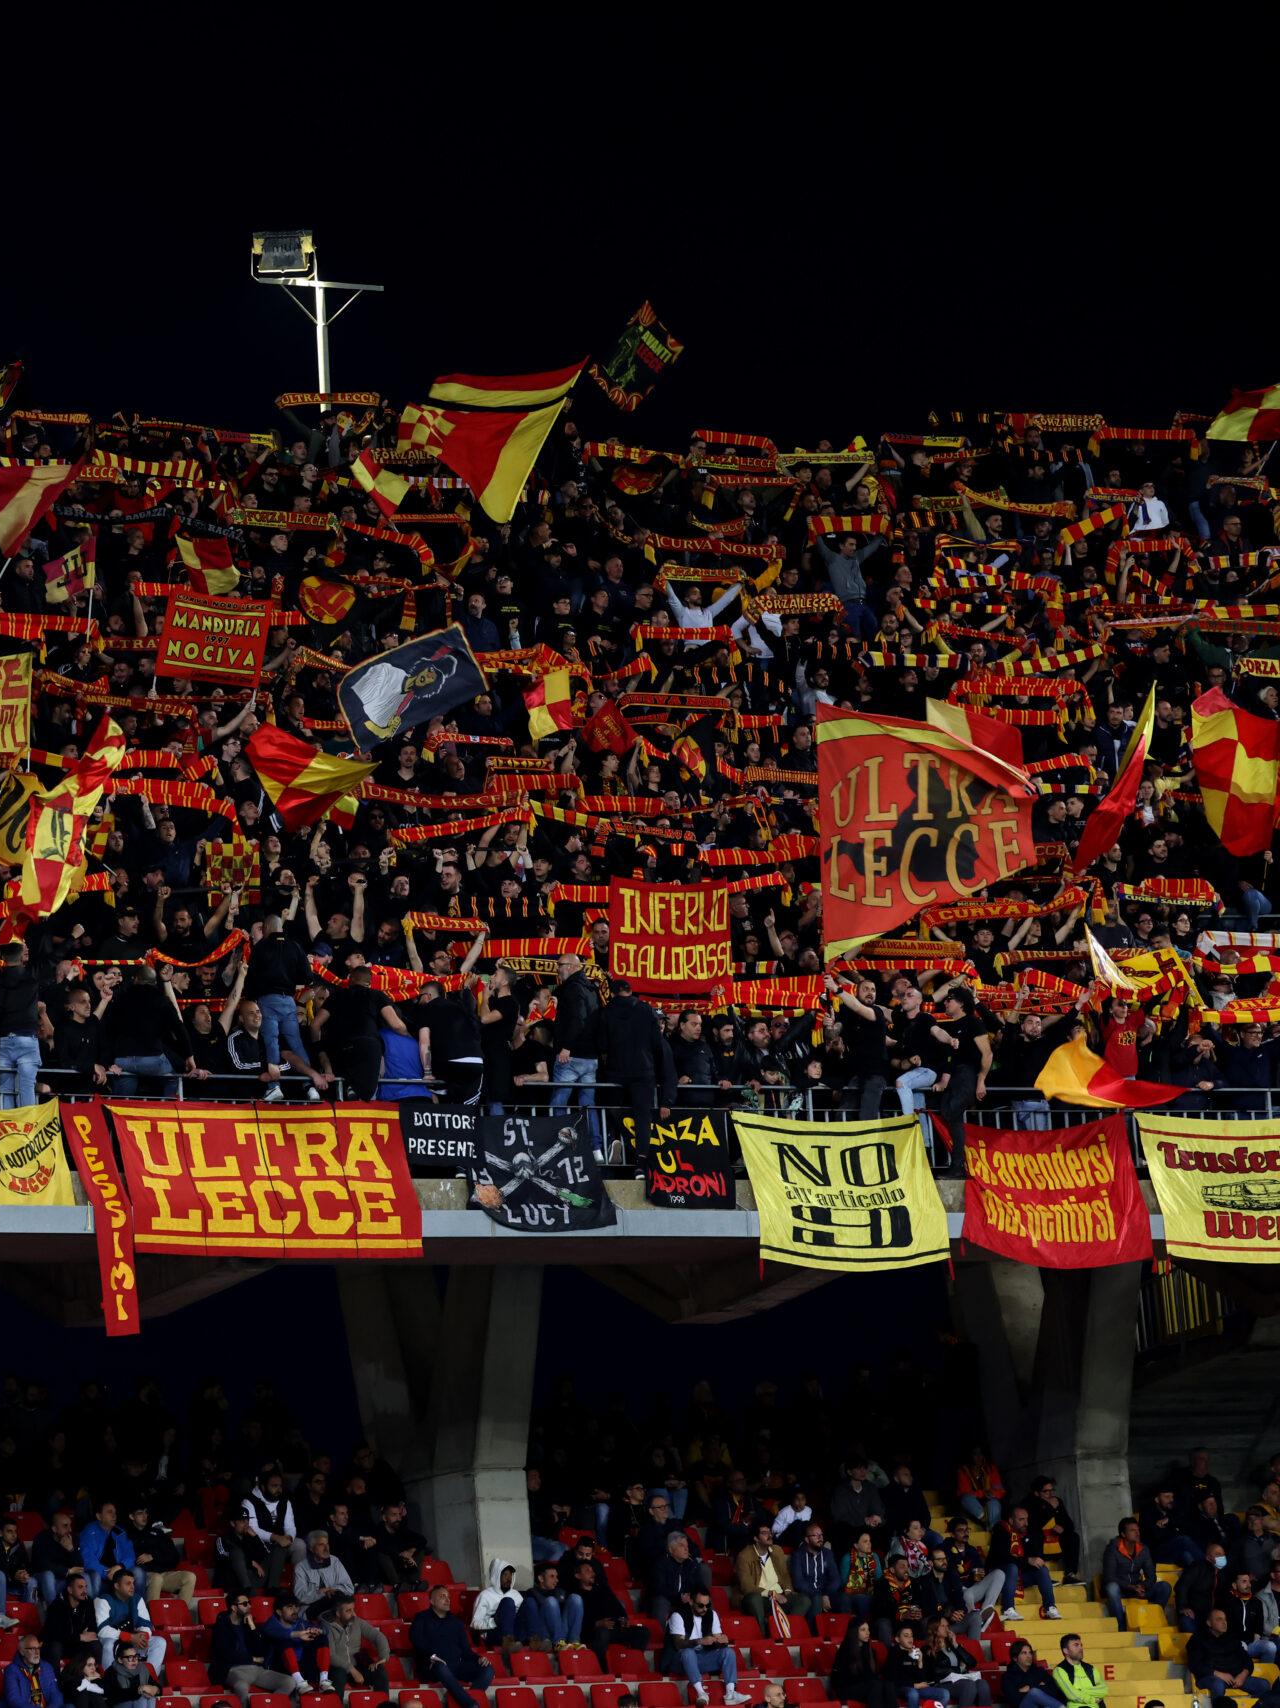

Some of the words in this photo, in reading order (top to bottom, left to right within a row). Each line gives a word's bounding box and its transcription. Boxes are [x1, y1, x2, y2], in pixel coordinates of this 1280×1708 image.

[640, 329, 674, 364] AVANTI
[281, 392, 321, 405] ULTRA
[288, 511, 327, 527] LECCE
[661, 535, 713, 550] CURVA
[720, 541, 773, 556] NORD
[177, 593, 209, 606] CURVA
[212, 600, 238, 610] NORD
[241, 602, 266, 611] LECCE
[800, 596, 832, 609] LECCE
[172, 610, 261, 638] MANDURIA
[204, 634, 231, 645] 1997
[166, 640, 256, 667] NOCIVA
[146, 700, 194, 717] NOCIVA
[369, 785, 433, 807] ULTRA
[441, 793, 501, 808] LECCE
[829, 820, 1028, 908] LECCE
[1125, 893, 1157, 904] CUORE
[1157, 896, 1213, 907] SALENTINO
[430, 917, 486, 930] ULTRA
[619, 888, 728, 936] INFERNO
[938, 904, 1022, 921] CURVA
[918, 942, 944, 951] NORD
[126, 1119, 393, 1179] ULTRA'
[771, 1142, 900, 1188] NO
[992, 1133, 1115, 1192] arrendersi
[141, 1175, 402, 1235] LECCE
[669, 1194, 686, 1204] 1998
[72, 1114, 135, 1321] PESSIMI
[503, 1203, 571, 1226] LUCY
[1023, 1190, 1117, 1249] pentirsi
